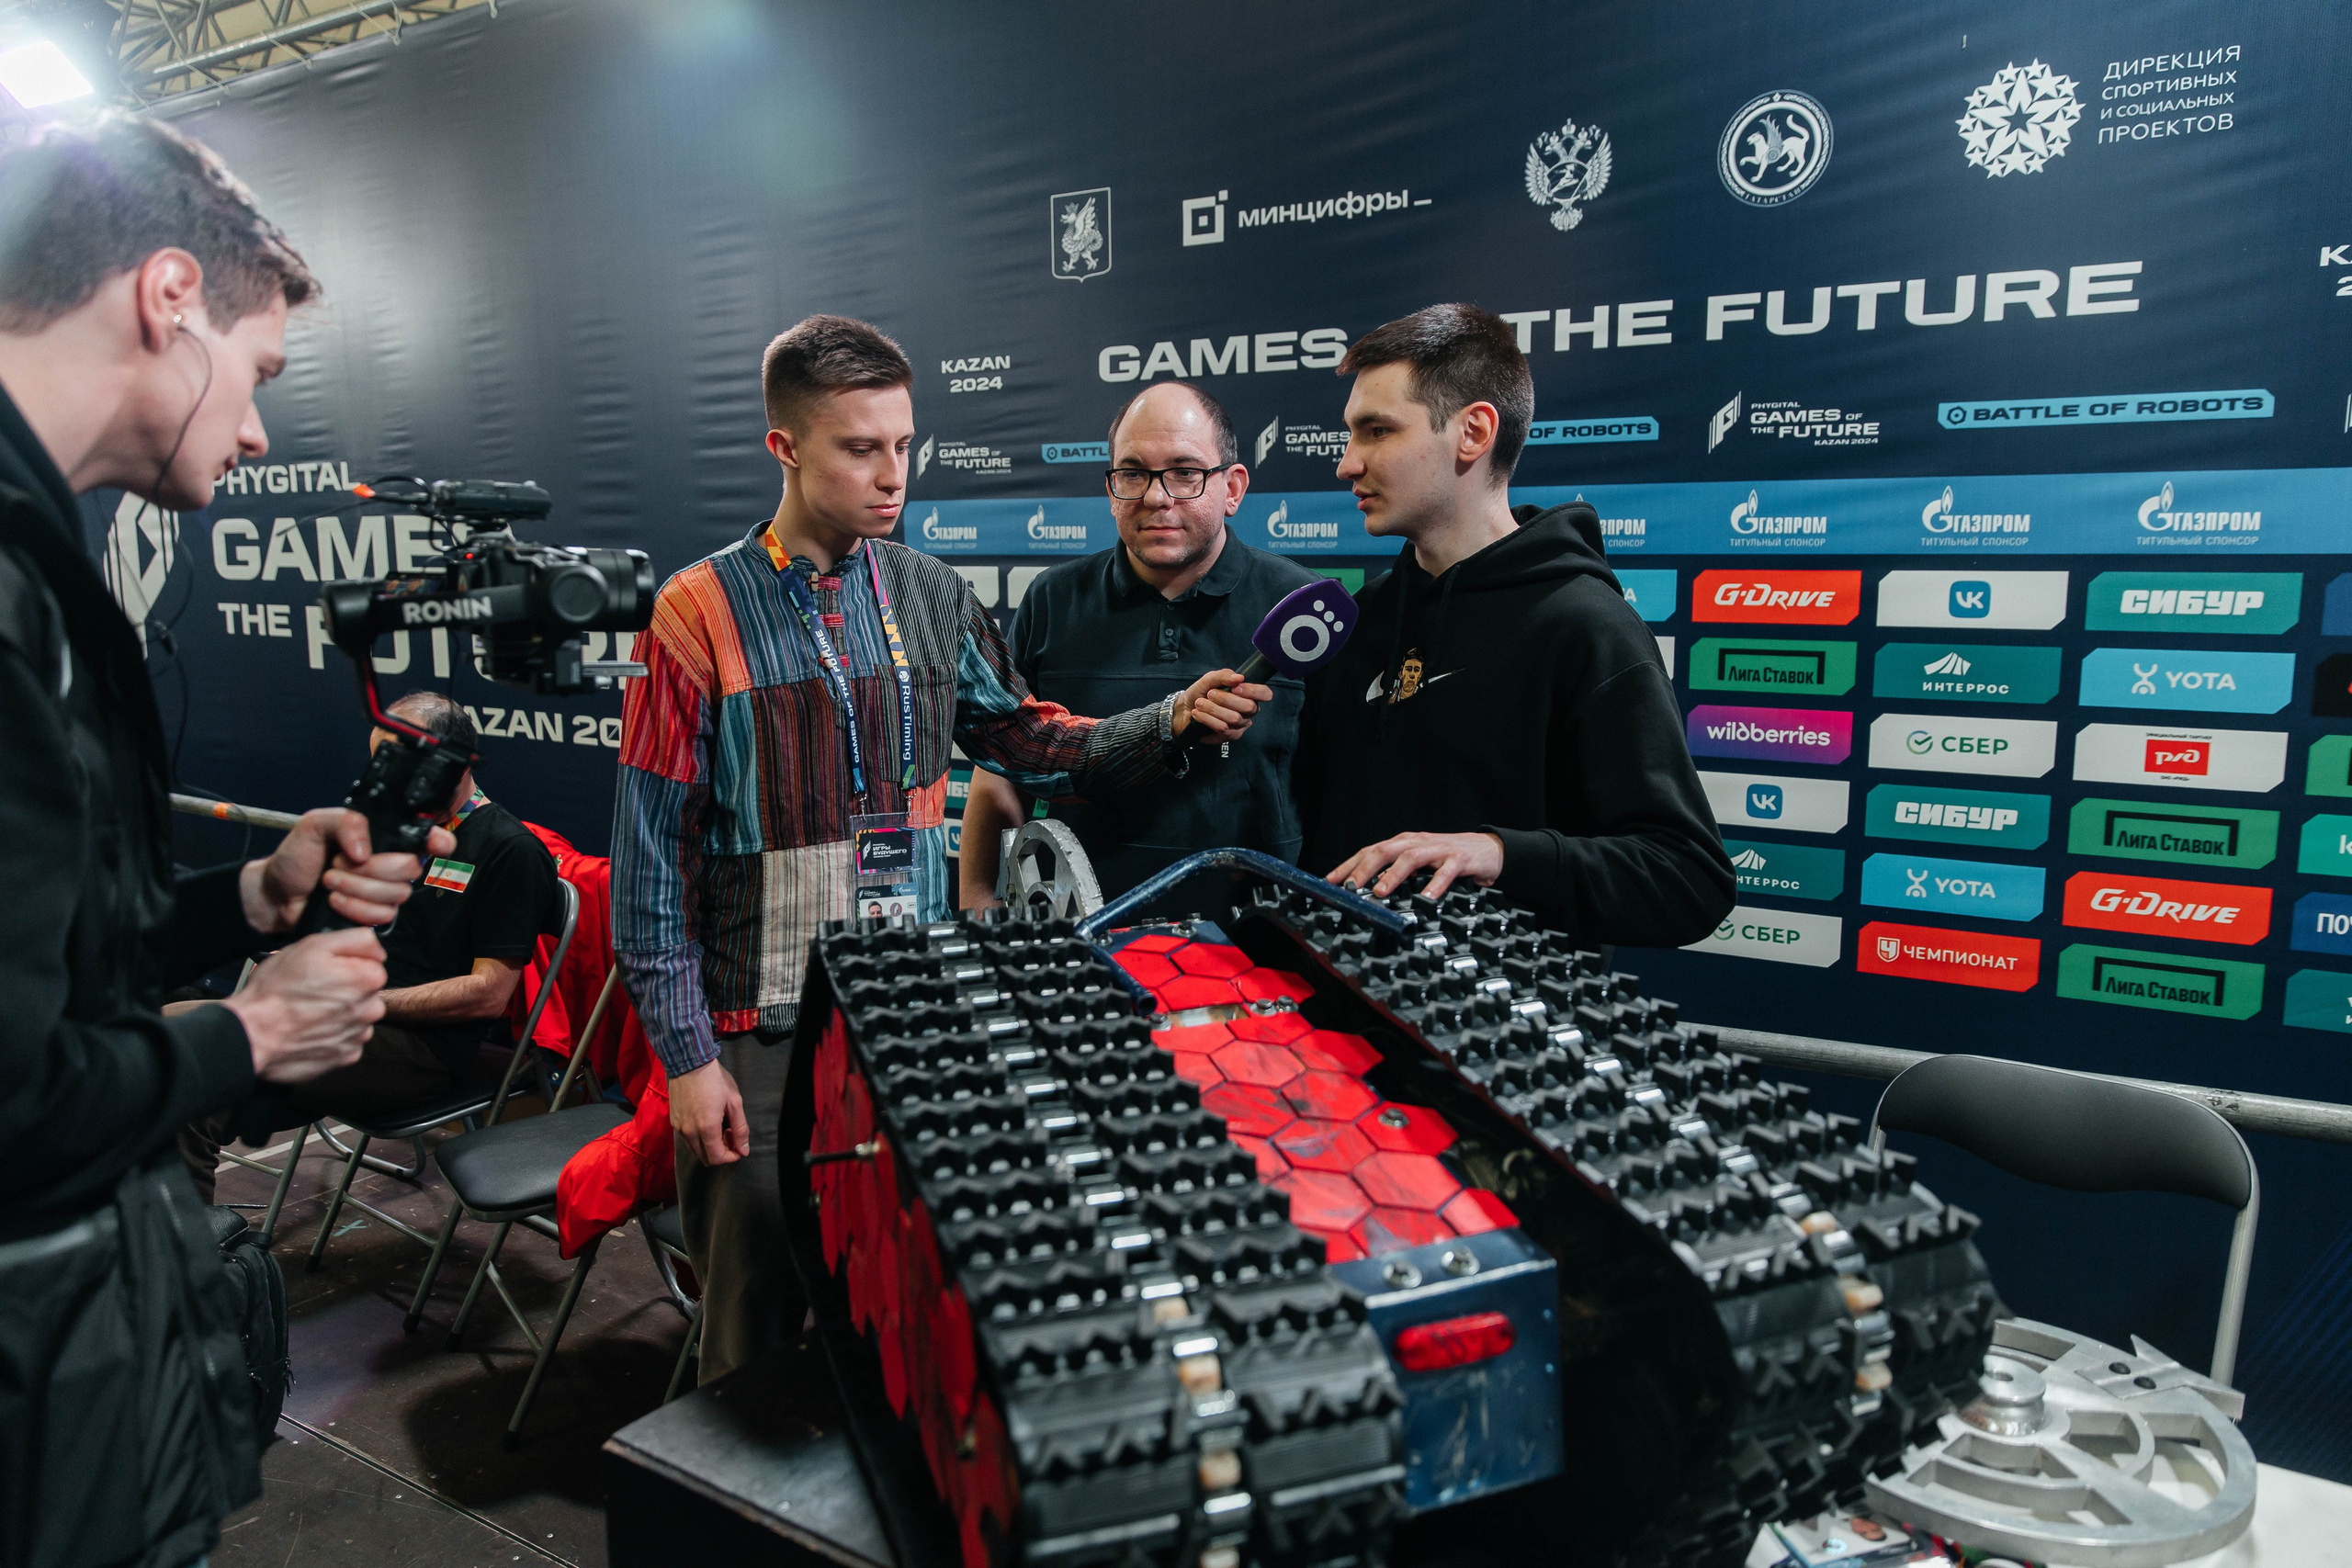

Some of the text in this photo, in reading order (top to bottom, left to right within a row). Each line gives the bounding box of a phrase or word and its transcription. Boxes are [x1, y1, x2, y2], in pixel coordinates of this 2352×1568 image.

[2103, 45, 2241, 83] ДИРЕКЦИЯ
[2101, 70, 2237, 100] СПОРТИВНЫХ
[2100, 92, 2235, 120] И СОЦИАЛЬНЫХ
[2098, 113, 2233, 144] ПРОЕКТОВ
[1098, 261, 2143, 383] GAMES THE FUTURE
[941, 355, 1011, 375] KAZAN
[949, 376, 1003, 393] 2024
[1750, 401, 1801, 410] PHYGITAL
[1973, 397, 2265, 421] BATTLE OF ROBOTS
[1750, 409, 1863, 424] GAMES OF
[1285, 431, 1351, 444] GAMES
[1529, 423, 1652, 438] OF ROBOTS
[1750, 423, 1881, 439] THE FUTURE
[1061, 446, 1107, 457] BATTL
[1814, 437, 1879, 446] KAZAN 2024
[939, 446, 990, 459] GAMES
[956, 457, 1012, 469] FUTURE
[1600, 519, 1646, 536] ЗПРОМ
[1758, 516, 1827, 535] ГАЗПРОМ
[1953, 513, 2031, 533] ГАЗПРОМ
[2173, 512, 2262, 532] ГАЗПРОМ
[1608, 539, 1645, 547] СПОНСОР
[1730, 537, 1826, 547] ТИТУЛЬНЫЙ СПОНСОР
[1921, 536, 2030, 547] ТИТУЛЬНЫЙ СПОНСОР
[2136, 536, 2259, 546] ТИТУЛЬНЫЙ СПОНСОР
[402, 595, 493, 625] RONIN
[1956, 591, 1984, 610] VK
[2120, 589, 2265, 615] СИБУР
[218, 603, 292, 637] THE
[837, 674, 850, 698] THE
[1922, 681, 2009, 694] ИНТЕРРОС
[2165, 671, 2237, 691] YOTA
[847, 701, 854, 716] OF
[463, 705, 622, 748] AZAN 20
[902, 685, 912, 761] RusTiming
[850, 720, 860, 763] GAMES
[1706, 721, 1831, 746] wildberries
[1941, 736, 2009, 756] СБЕР
[1752, 793, 1777, 811] VK
[1894, 800, 2018, 831] СИБУР
[1736, 875, 1800, 890] НТЕРРОС
[1934, 877, 1996, 898] YOTA
[1741, 924, 1801, 944] СБЕР
[1904, 944, 2018, 971] ЧЕМПИОНАТ
